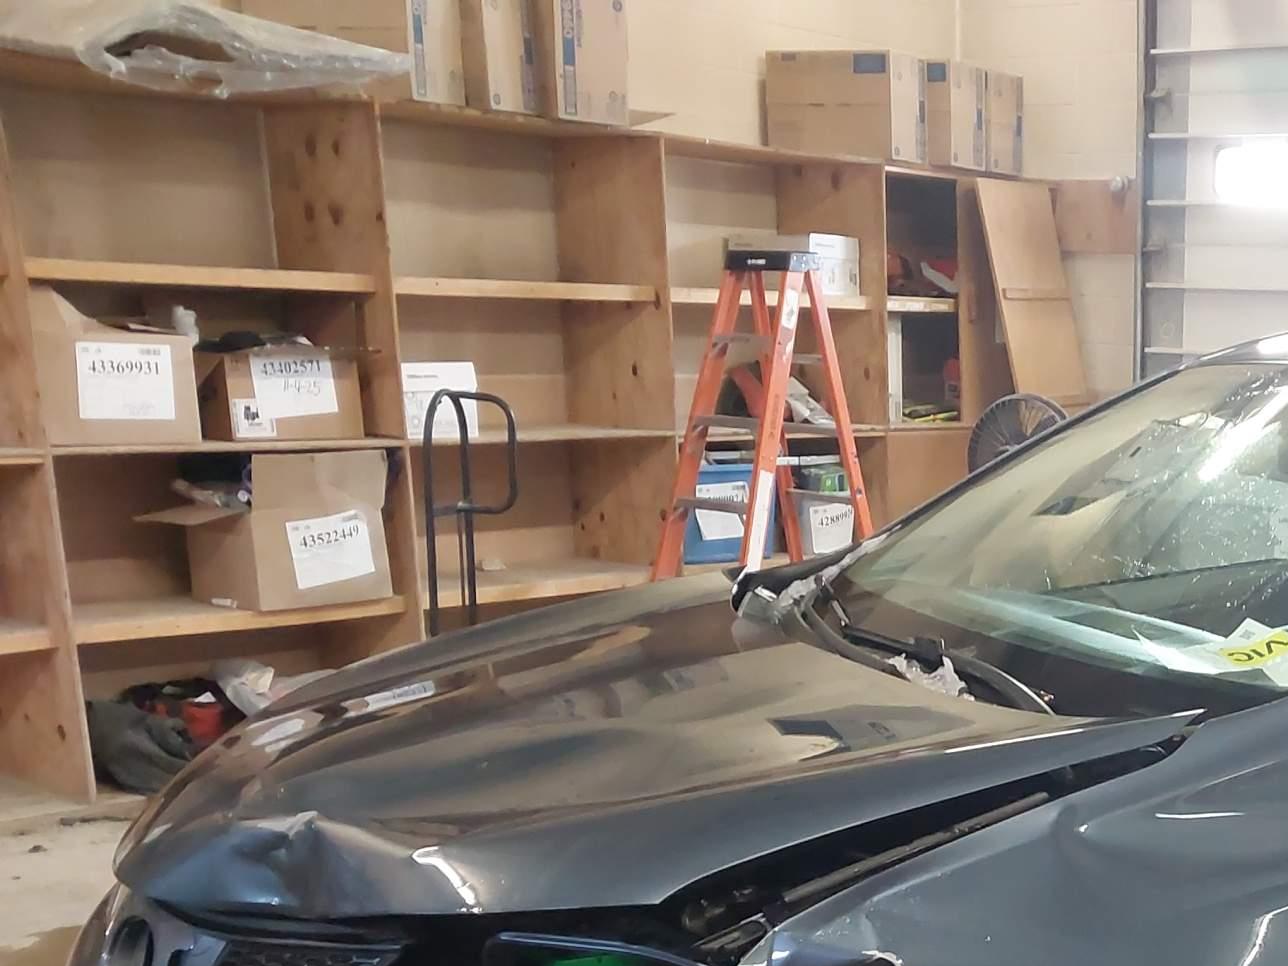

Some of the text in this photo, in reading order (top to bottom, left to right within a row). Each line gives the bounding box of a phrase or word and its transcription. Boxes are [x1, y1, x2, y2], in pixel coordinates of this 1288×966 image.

[88, 359, 160, 375] 43369931
[261, 359, 321, 376] 43402571
[299, 524, 360, 548] 43522449
